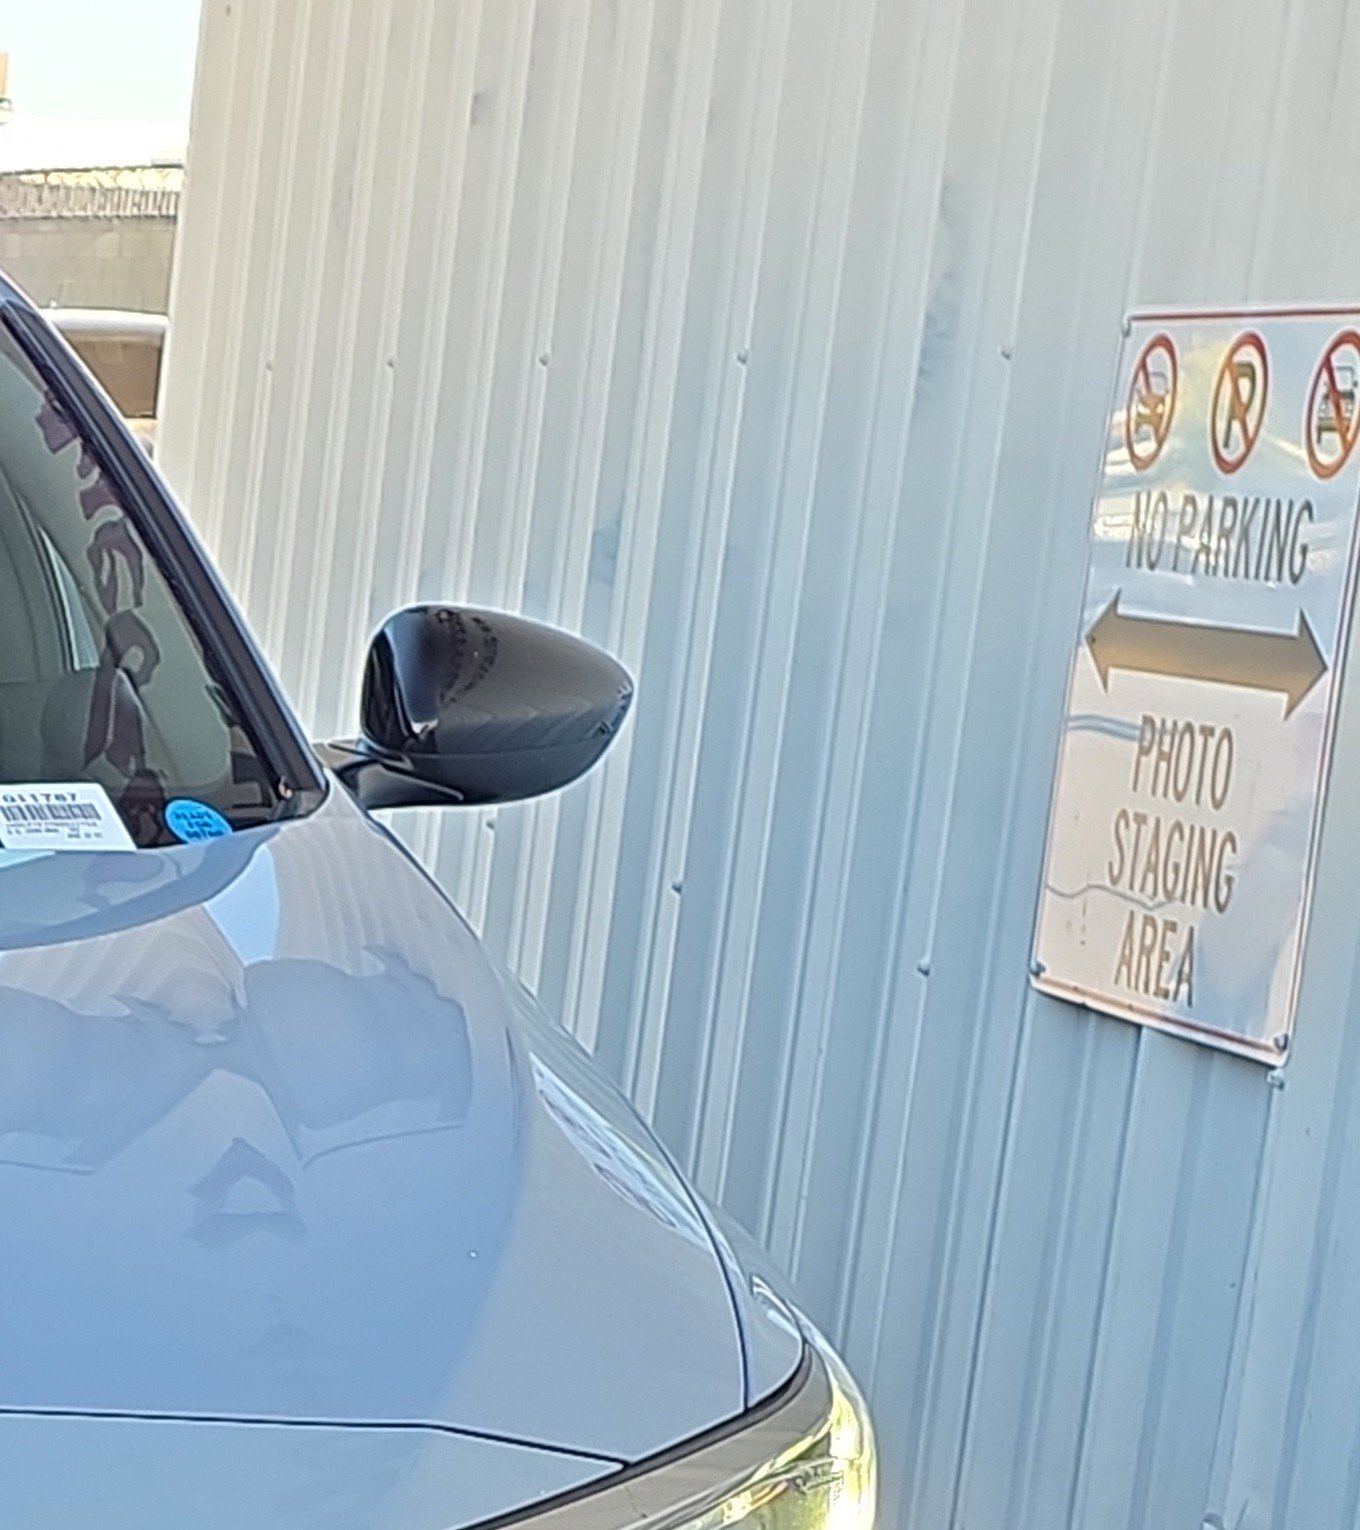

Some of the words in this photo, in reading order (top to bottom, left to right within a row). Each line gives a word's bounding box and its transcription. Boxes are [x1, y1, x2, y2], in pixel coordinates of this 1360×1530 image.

[1125, 490, 1169, 571] NO
[1172, 493, 1315, 585] PARKING
[1133, 714, 1233, 810] PHOTO
[1108, 808, 1237, 914] STAGING
[1114, 909, 1195, 1008] AREA
